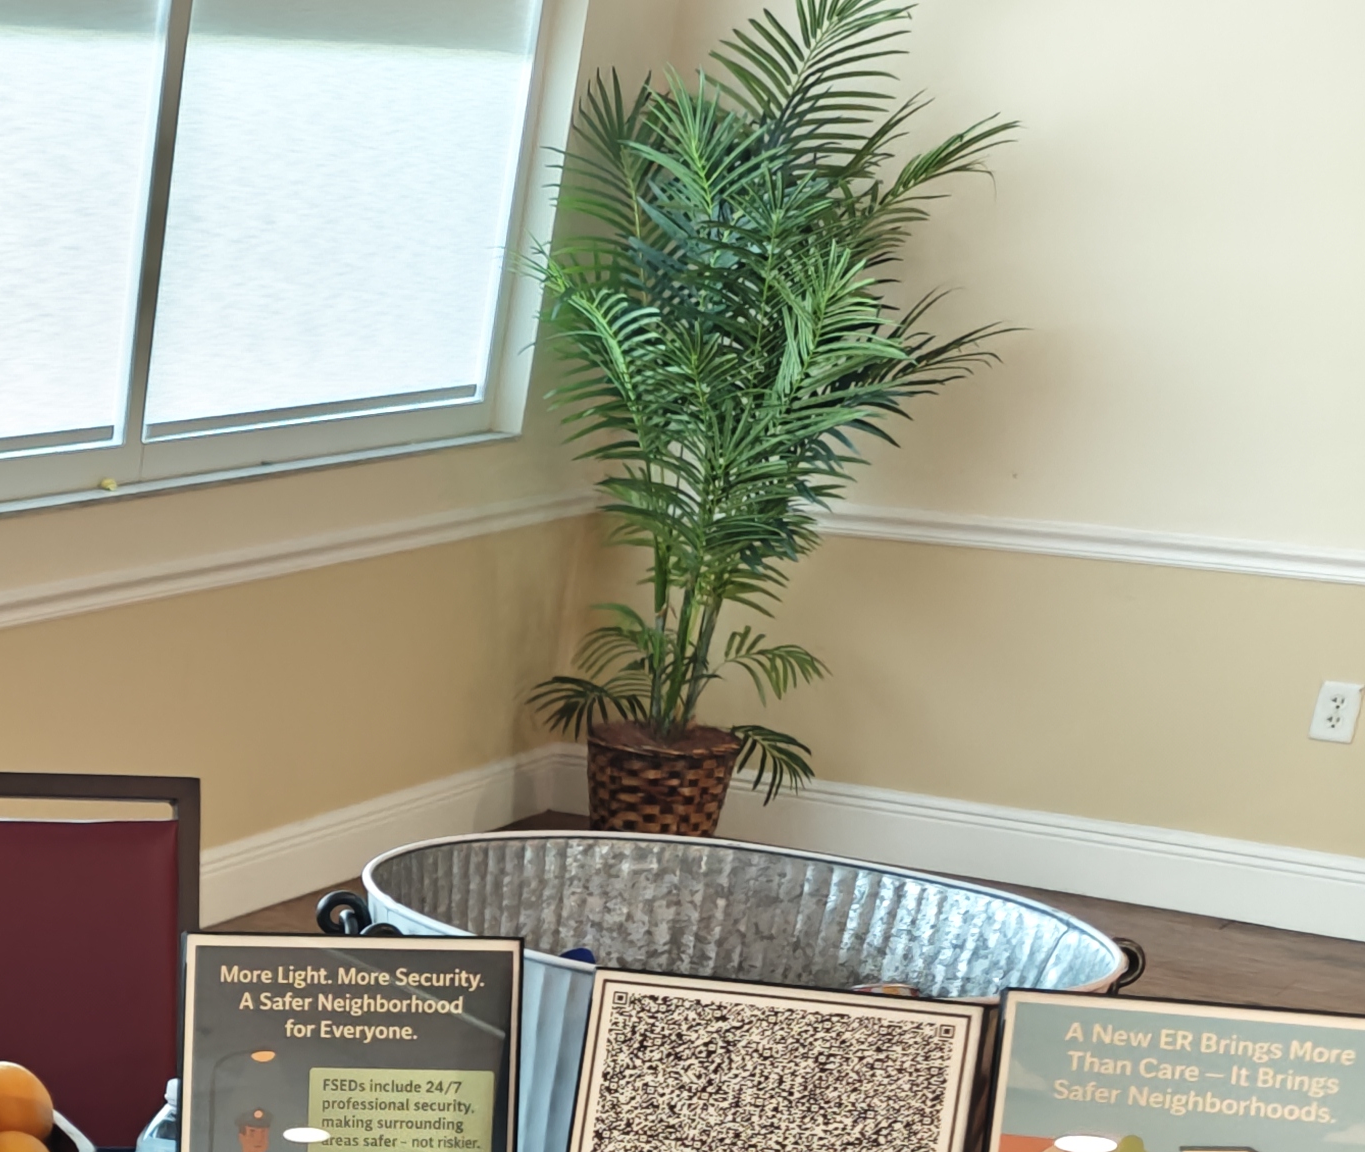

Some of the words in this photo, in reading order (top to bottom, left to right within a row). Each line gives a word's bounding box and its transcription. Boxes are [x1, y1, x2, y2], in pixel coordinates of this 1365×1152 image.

[220, 965, 272, 983] More
[277, 966, 332, 988] Light.
[338, 968, 390, 985] More
[395, 968, 485, 991] Security.
[239, 992, 253, 1010] A
[259, 993, 312, 1011] Safer
[318, 993, 463, 1016] Neighborhood
[285, 1019, 315, 1037] for
[320, 1021, 417, 1043] Everyone.
[1065, 1022, 1083, 1042] A
[1092, 1023, 1152, 1047] New
[1160, 1029, 1193, 1051] ER
[1200, 1033, 1283, 1063] Brings
[1289, 1040, 1355, 1066] More
[1068, 1050, 1131, 1075] Than
[1139, 1058, 1199, 1082] Care
[1231, 1065, 1249, 1087] It
[1257, 1068, 1340, 1097] Brings
[323, 1079, 365, 1092] FSEDs
[370, 1080, 421, 1092] include
[426, 1081, 462, 1095] 24/7
[322, 1098, 409, 1112] professional
[1054, 1079, 1122, 1104] Safer
[1128, 1086, 1337, 1124] Neighborhoods.
[322, 1116, 373, 1131] making
[377, 1118, 464, 1133] surrounding
[321, 1136, 359, 1146] areas
[363, 1135, 397, 1147] safer
[412, 1137, 433, 1148] not
[438, 1137, 481, 1149] riskier.
